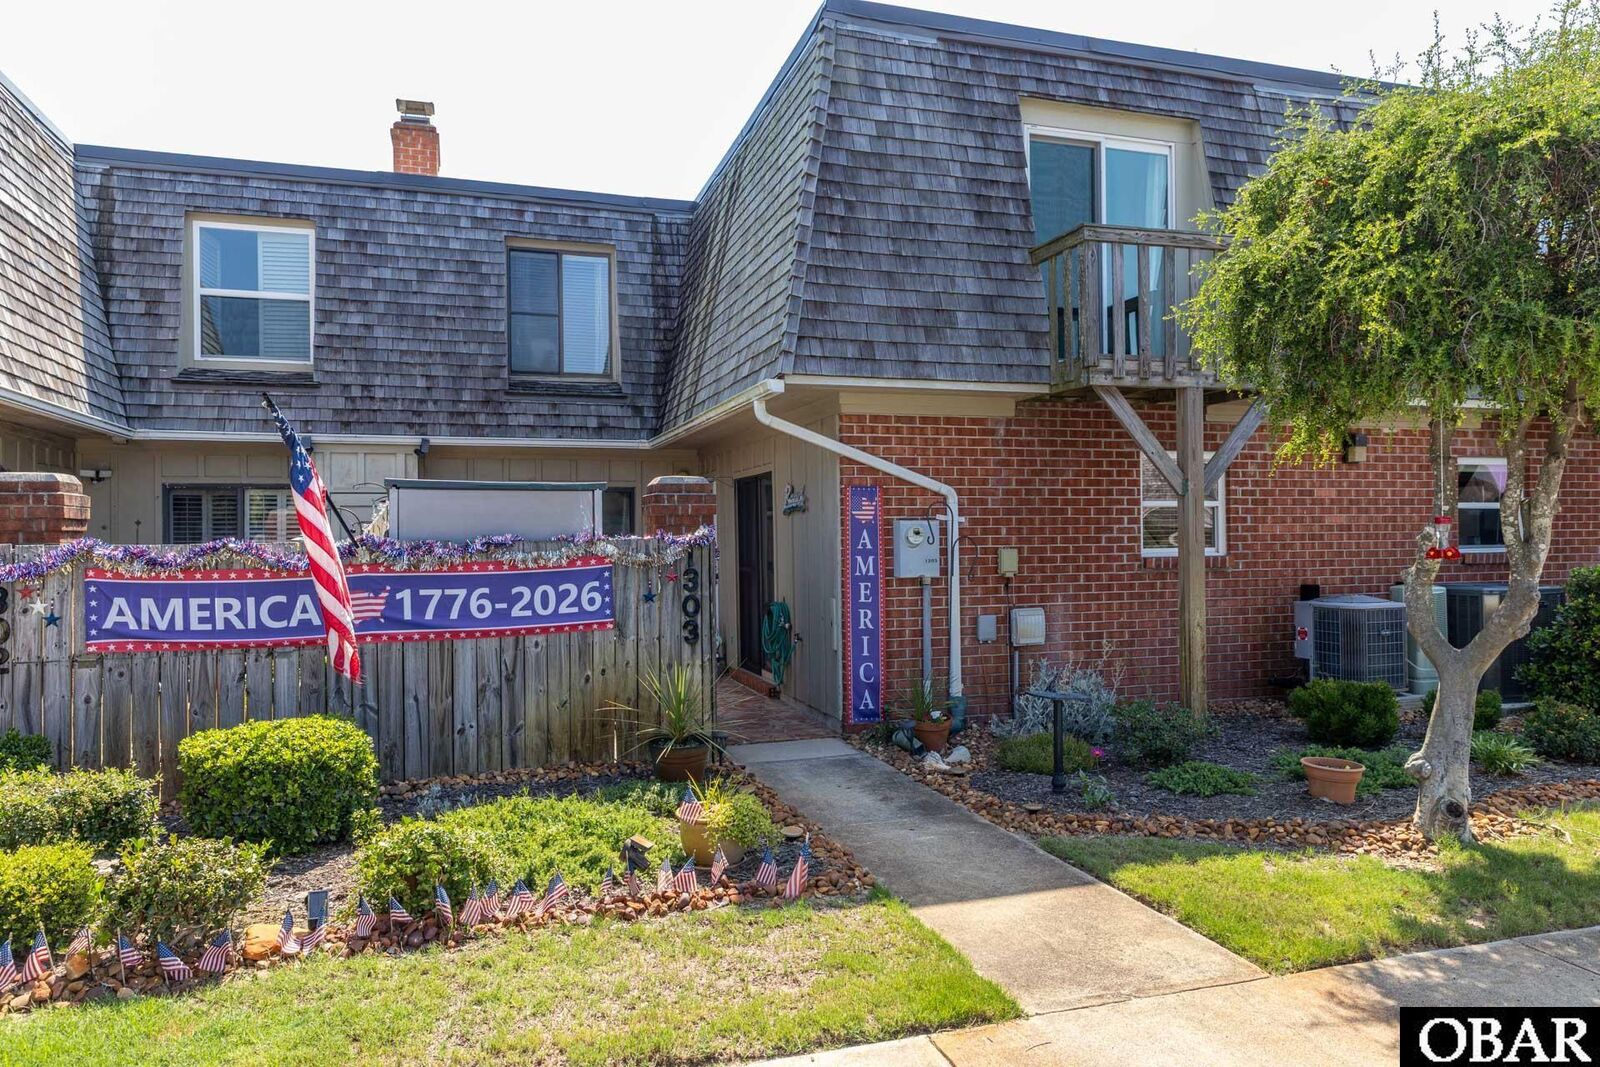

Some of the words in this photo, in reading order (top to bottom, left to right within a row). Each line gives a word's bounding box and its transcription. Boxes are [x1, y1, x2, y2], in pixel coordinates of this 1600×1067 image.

[102, 594, 322, 631] AMERICA
[395, 581, 603, 621] 1776-2026
[854, 528, 876, 710] AMERICA
